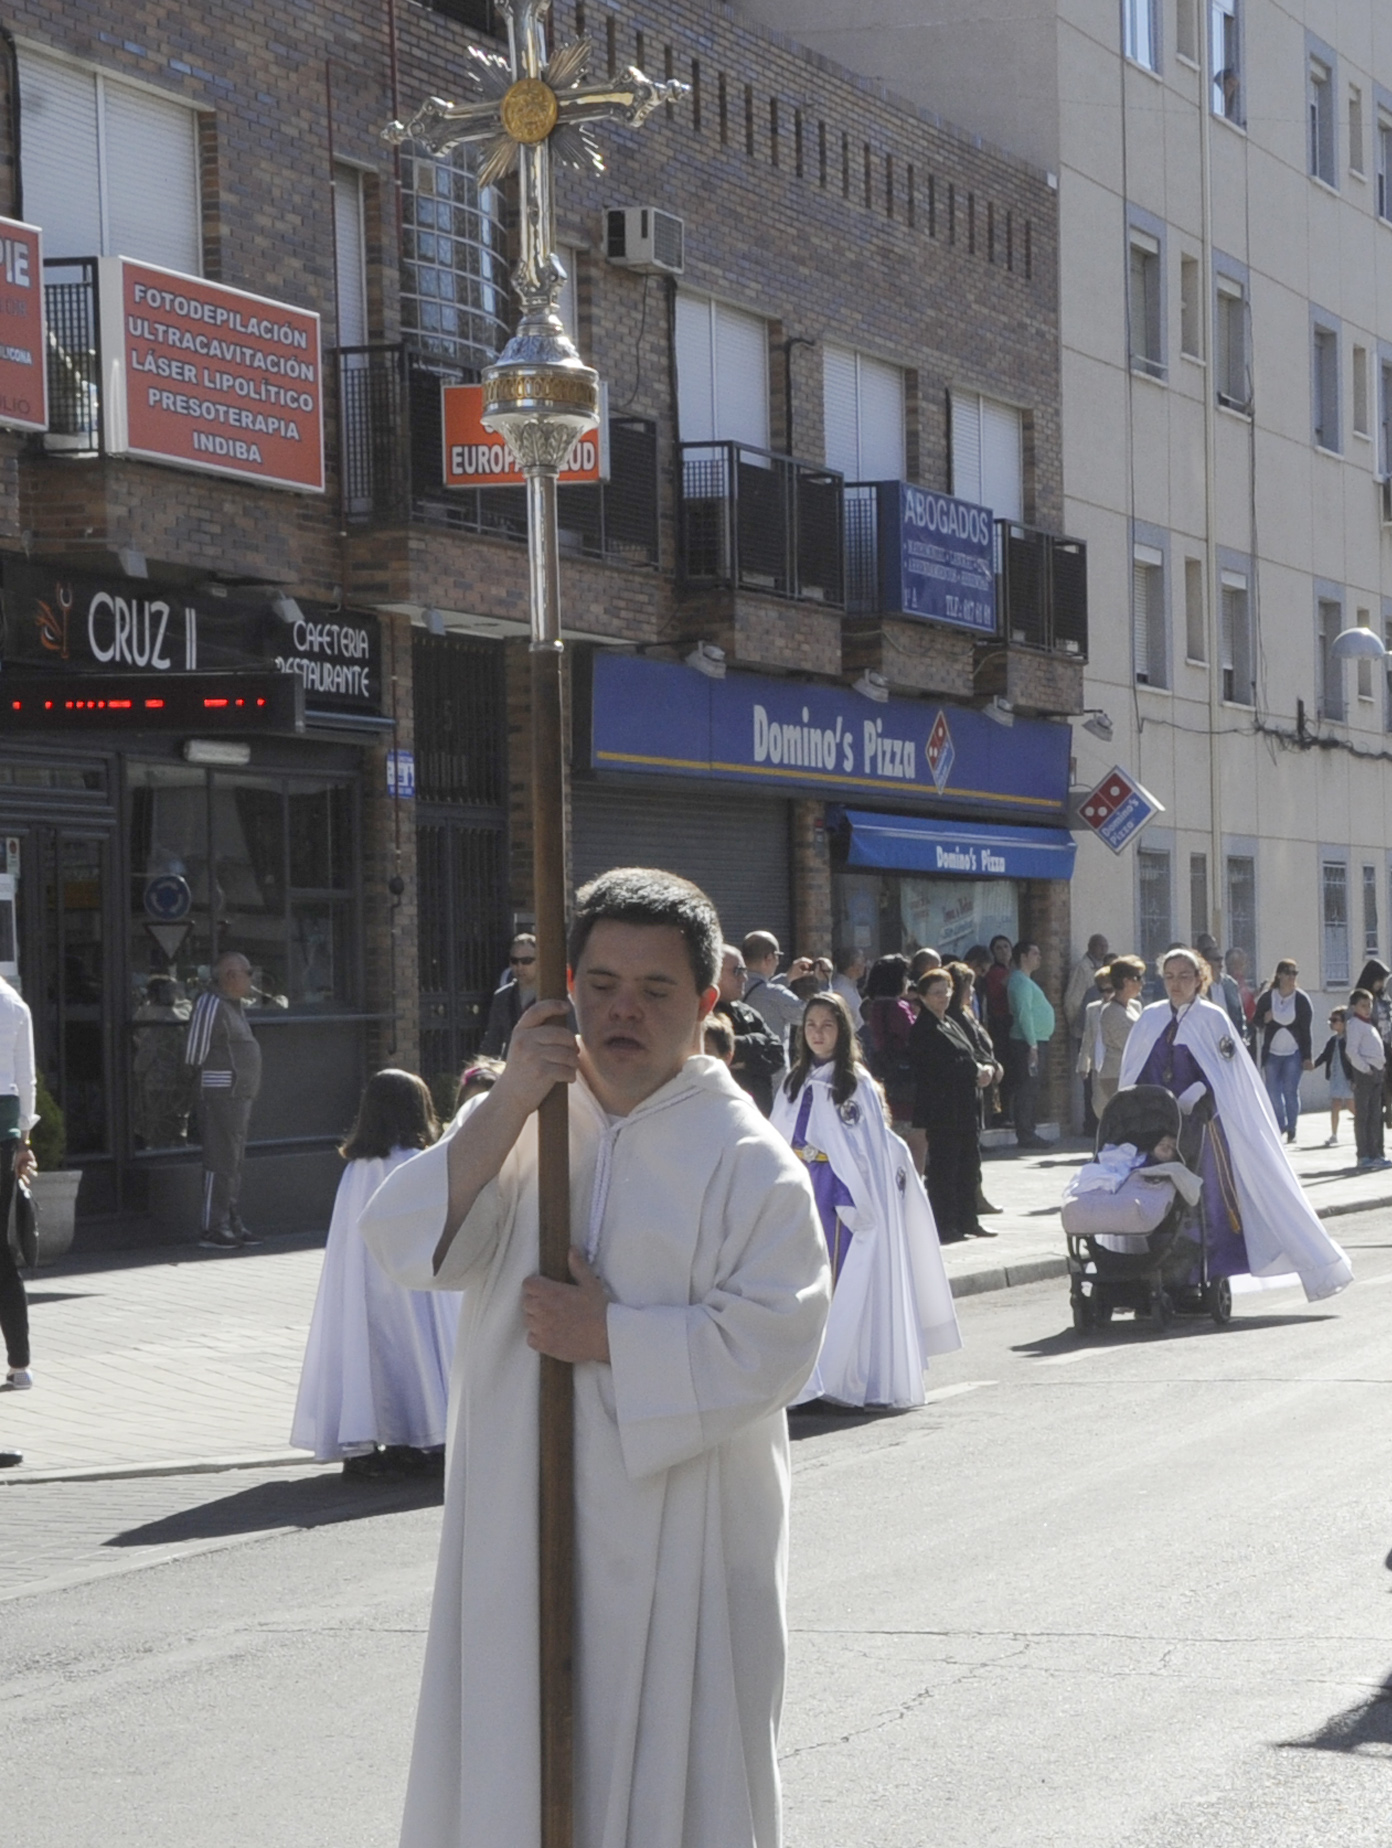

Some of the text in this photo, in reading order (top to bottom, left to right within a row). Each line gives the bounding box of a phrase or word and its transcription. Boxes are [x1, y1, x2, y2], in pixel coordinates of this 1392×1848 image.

[0, 238, 30, 288] IE
[134, 284, 308, 349] FOTODEPILACIÓN
[128, 316, 315, 382] ULTRACAVITACIÓN
[131, 350, 314, 412] LÁSER LIPOLÍTICO
[148, 387, 300, 441] PRESOTERAPIA
[193, 431, 263, 463] INDIBA
[904, 489, 989, 546] ABOGADOS
[88, 591, 197, 670] CRUZ II
[293, 620, 369, 660] CAFETERIA
[753, 704, 854, 773] Domino's
[863, 717, 916, 779] Pizza
[936, 845, 977, 872] Domino's
